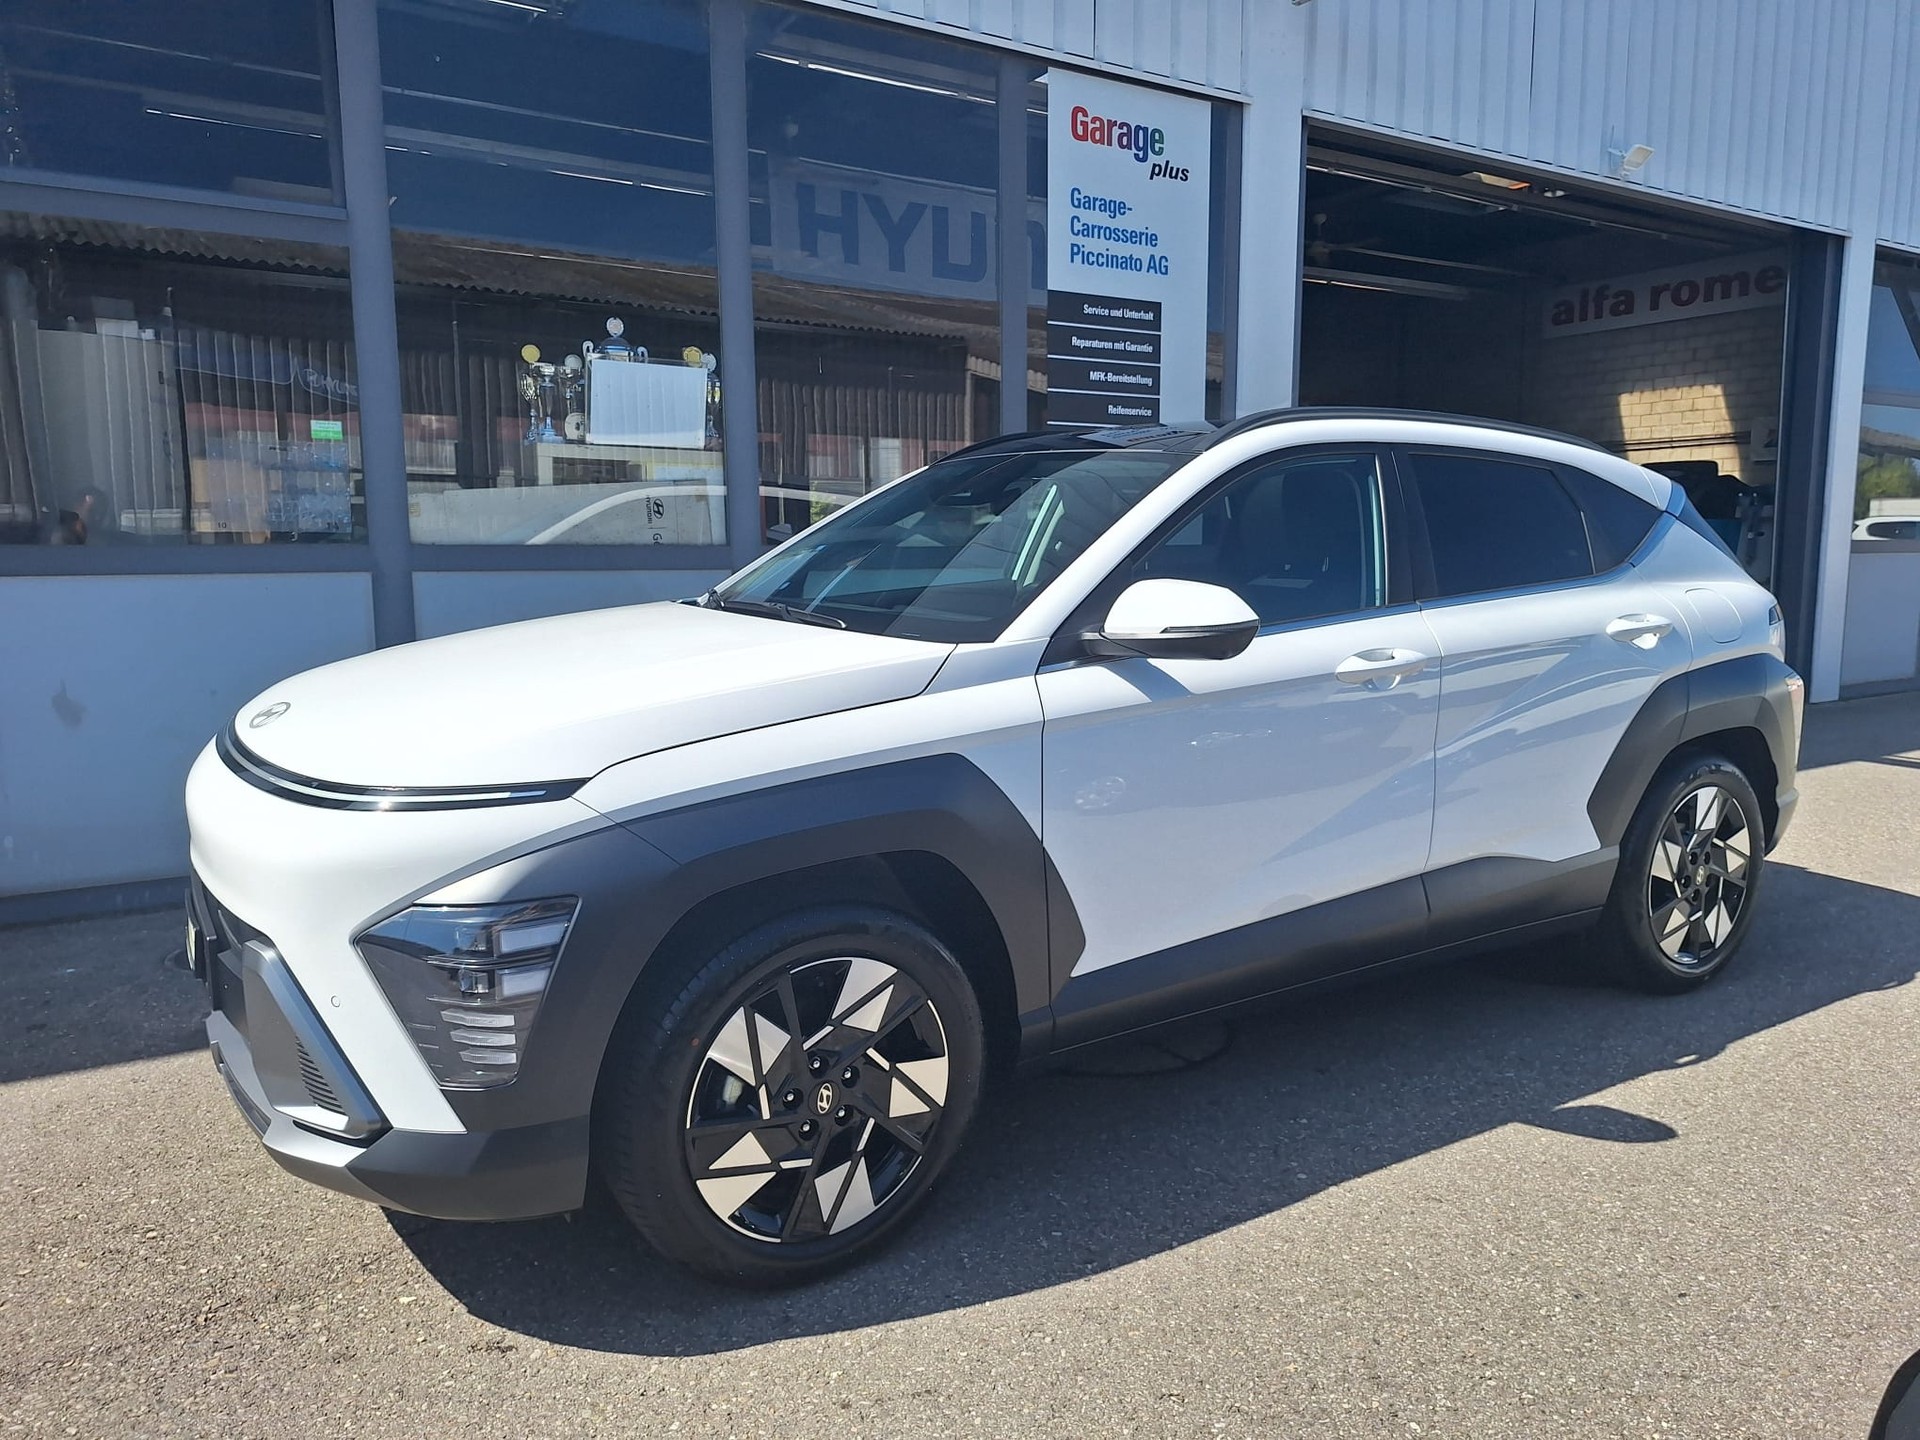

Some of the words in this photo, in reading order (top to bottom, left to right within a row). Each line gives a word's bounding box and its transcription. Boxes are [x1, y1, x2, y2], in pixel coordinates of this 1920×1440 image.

[1070, 105, 1165, 163] Garage
[1149, 160, 1190, 182] plus
[1070, 187, 1133, 219] Garage-
[1070, 215, 1158, 248] Carrosserie
[1070, 242, 1143, 273] Piccinato
[1146, 254, 1169, 276] AG
[1083, 303, 1110, 317] Service
[1109, 307, 1123, 318] und
[1123, 308, 1154, 321] Unterhalt
[1551, 284, 1635, 326] alfa
[1071, 336, 1113, 350] Reparaturen
[1113, 340, 1125, 351] mit
[1125, 341, 1153, 353] Garantie
[1089, 370, 1153, 387] MFK-Bereitstellung
[1107, 405, 1152, 417] Reifenservice
